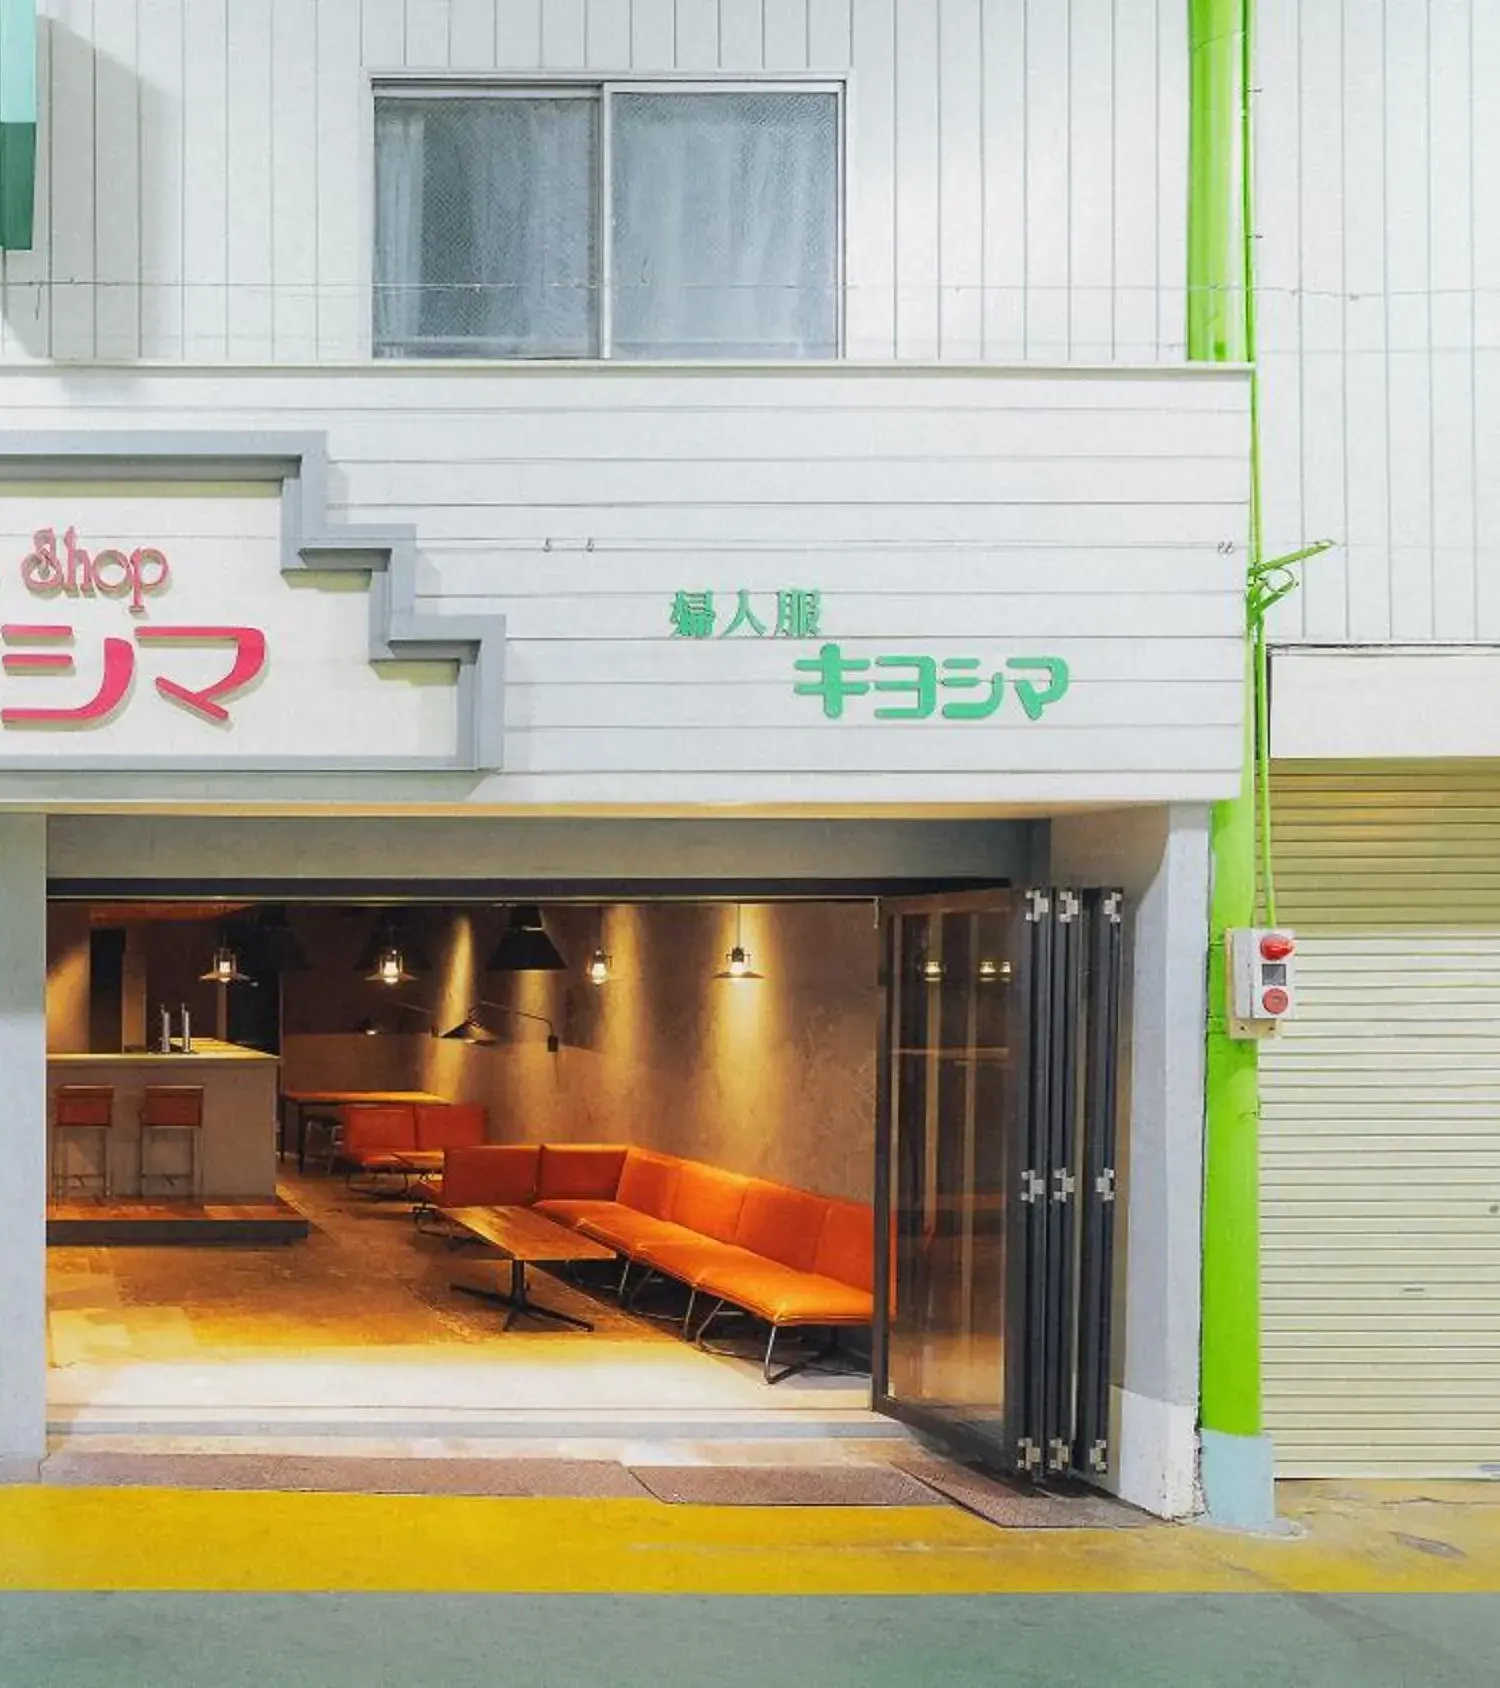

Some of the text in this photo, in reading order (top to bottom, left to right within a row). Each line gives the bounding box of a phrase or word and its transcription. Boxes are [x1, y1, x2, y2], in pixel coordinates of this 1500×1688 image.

[21, 524, 170, 614] Shop
[670, 589, 821, 638] 婦人服
[794, 643, 1071, 721] キヨシマ
